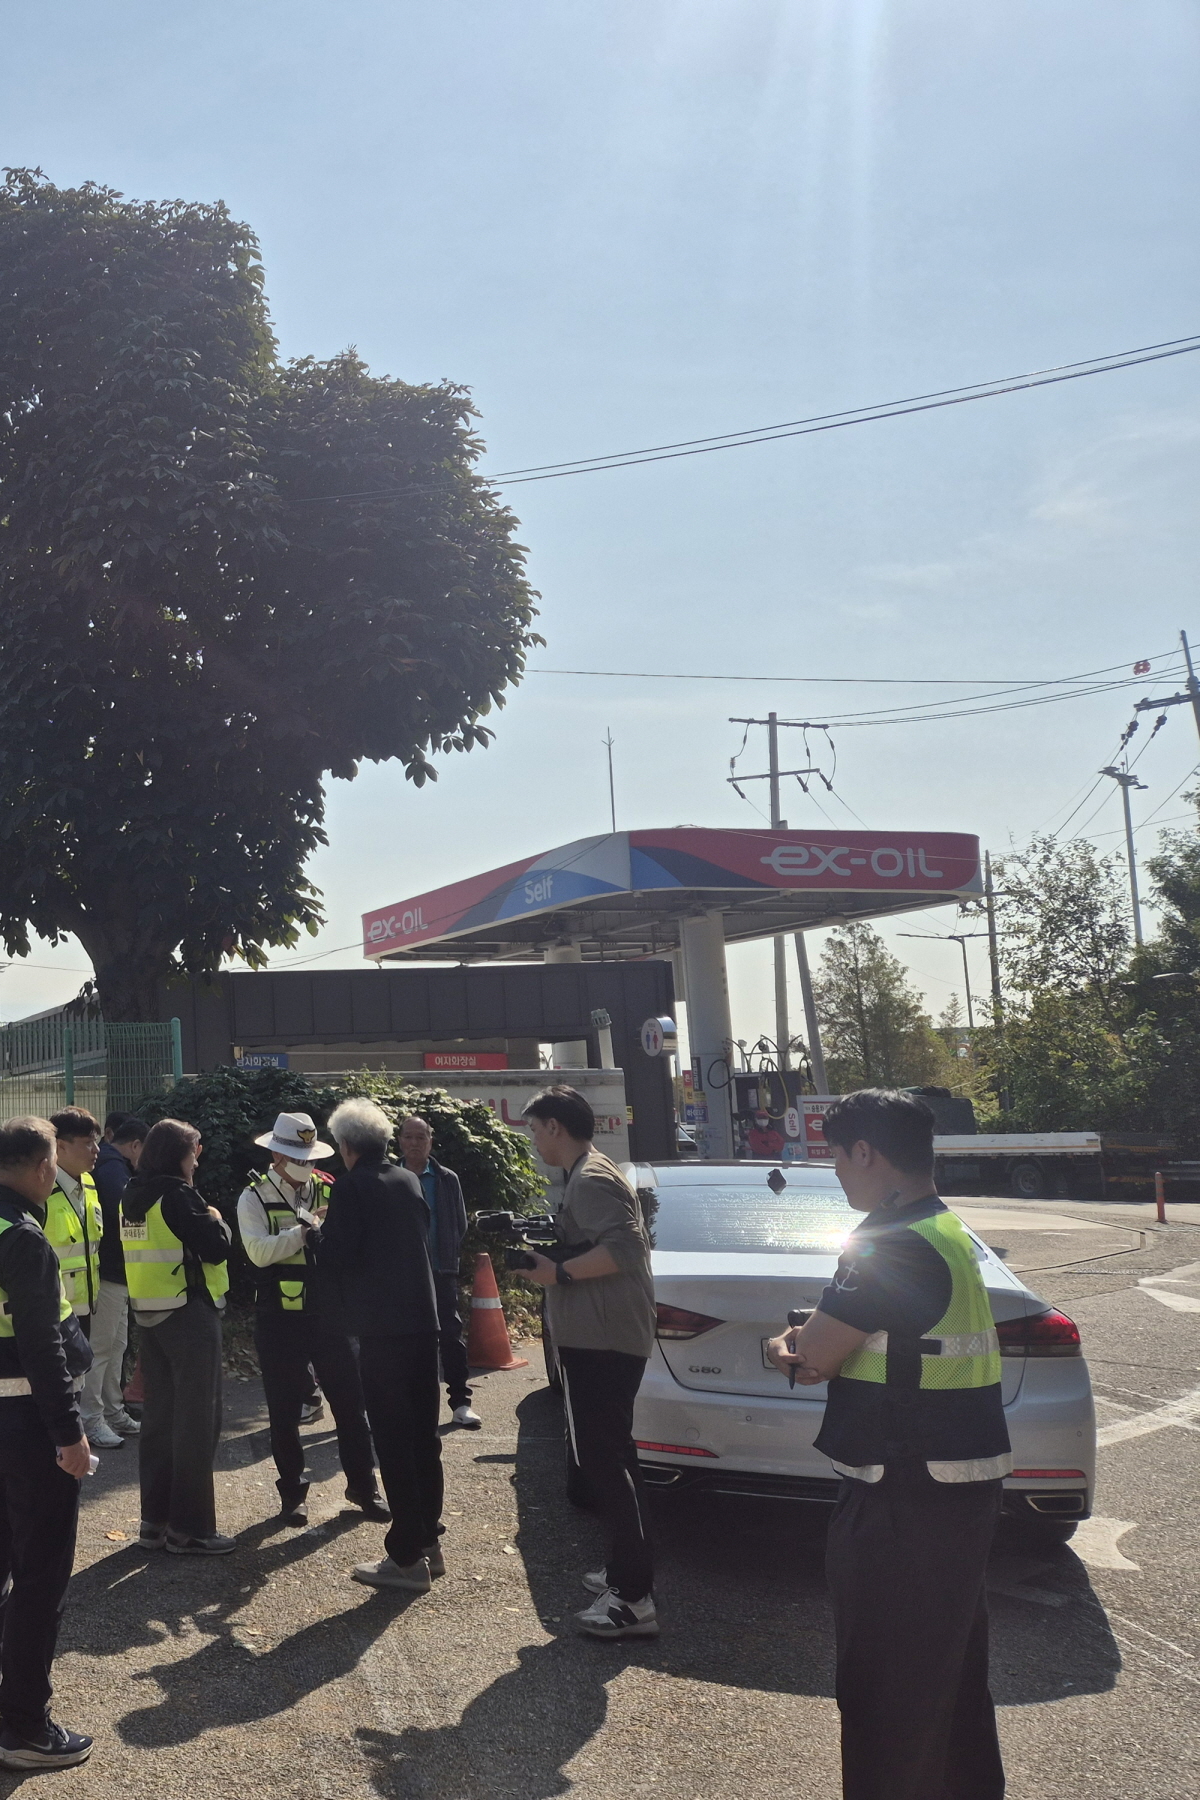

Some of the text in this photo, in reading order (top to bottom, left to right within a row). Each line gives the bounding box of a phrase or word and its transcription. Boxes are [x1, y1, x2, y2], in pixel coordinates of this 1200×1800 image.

[524, 876, 554, 905] Self
[435, 1056, 477, 1067] 여자화장실
[788, 1113, 797, 1132] Self
[688, 1365, 722, 1375] G80
